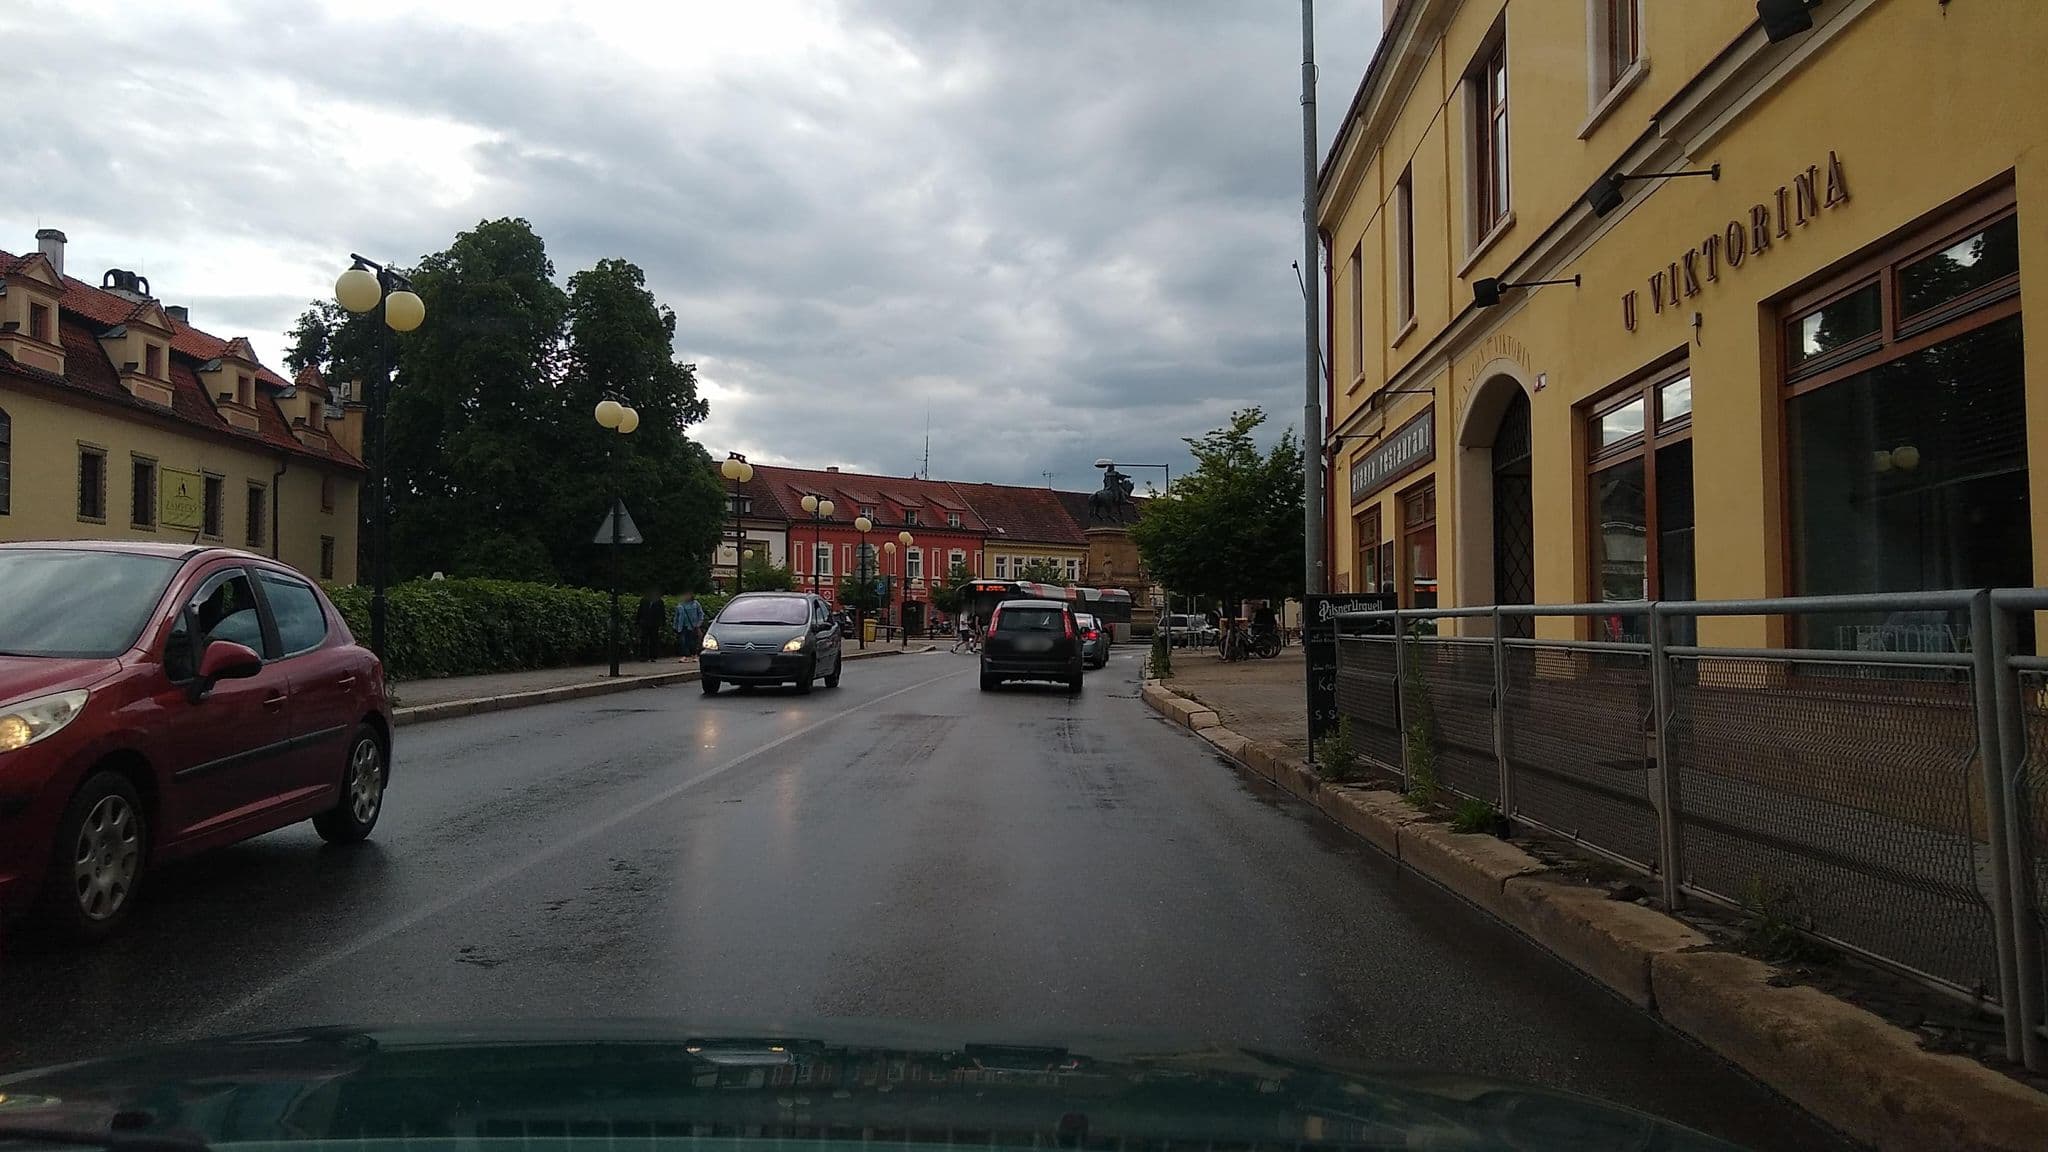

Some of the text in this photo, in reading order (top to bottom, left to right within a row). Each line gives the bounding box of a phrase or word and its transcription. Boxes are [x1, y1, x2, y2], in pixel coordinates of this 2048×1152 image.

[1621, 149, 1850, 332] U VIKTORINA
[1379, 424, 1430, 475] restaurant
